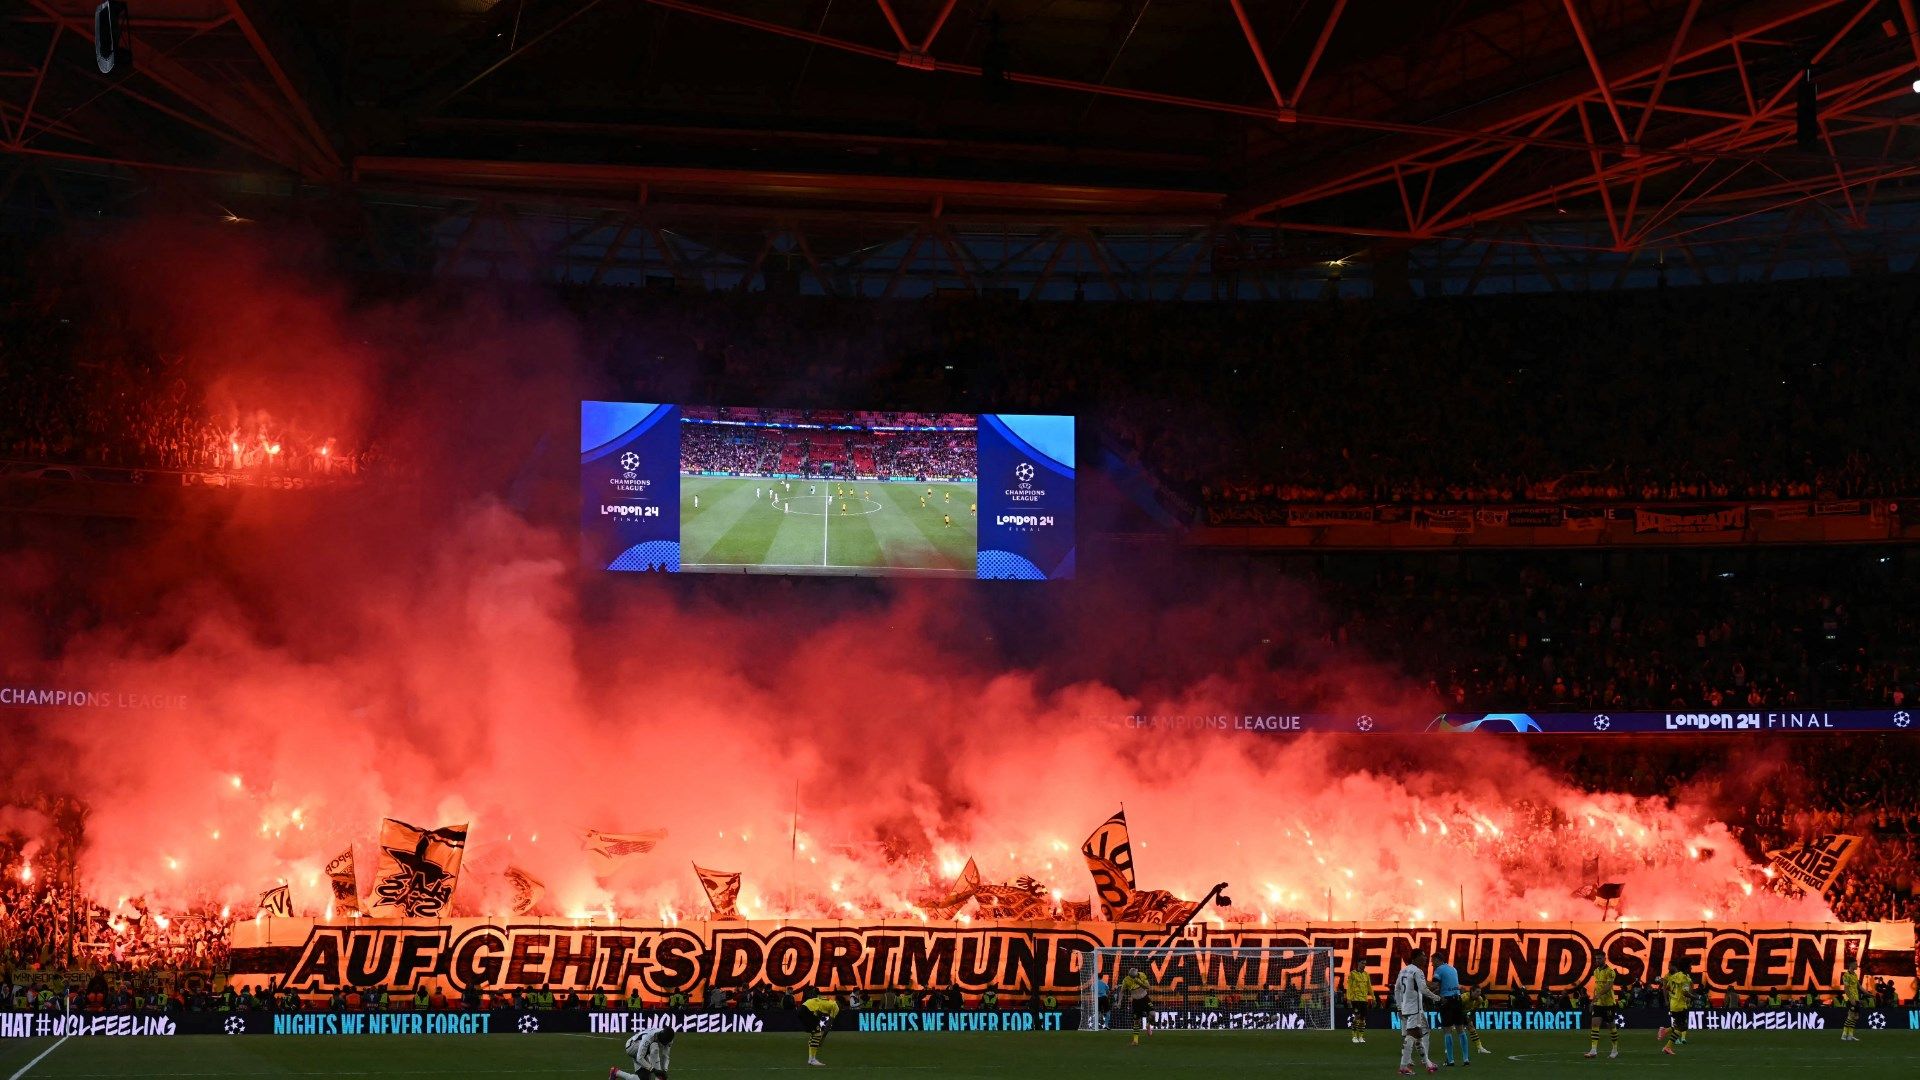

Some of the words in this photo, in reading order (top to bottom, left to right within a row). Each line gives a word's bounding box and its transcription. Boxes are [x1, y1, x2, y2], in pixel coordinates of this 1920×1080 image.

[609, 478, 651, 486] CHAMPIONS
[644, 506, 659, 517] 24
[1039, 516, 1054, 526] 24
[0, 688, 111, 707] CHAMPIONS
[1124, 715, 1227, 730] CHAMPIONS
[1234, 716, 1301, 730] LEAGUE
[1736, 713, 1761, 729] 24
[1767, 713, 1834, 728] FINAL
[286, 930, 446, 989] AUF
[711, 930, 1097, 989] DORTMUND
[1113, 923, 1437, 990] KÄMPFEN
[1446, 931, 1587, 990] UND
[1400, 975, 1409, 995] 5
[0, 1013, 34, 1037] HAT
[273, 1013, 337, 1035] NIGHTS
[341, 1013, 366, 1034] WE
[369, 1013, 423, 1034] NEVER
[427, 1013, 490, 1034] FORGET
[588, 1013, 630, 1033] THAT
[859, 1012, 918, 1032] NIGHTS
[921, 1012, 945, 1031] WE
[948, 1012, 999, 1031] NEVER
[1003, 1012, 1063, 1031] FORET
[1475, 1011, 1523, 1030] NEVER
[1526, 1011, 1583, 1030] FORGET
